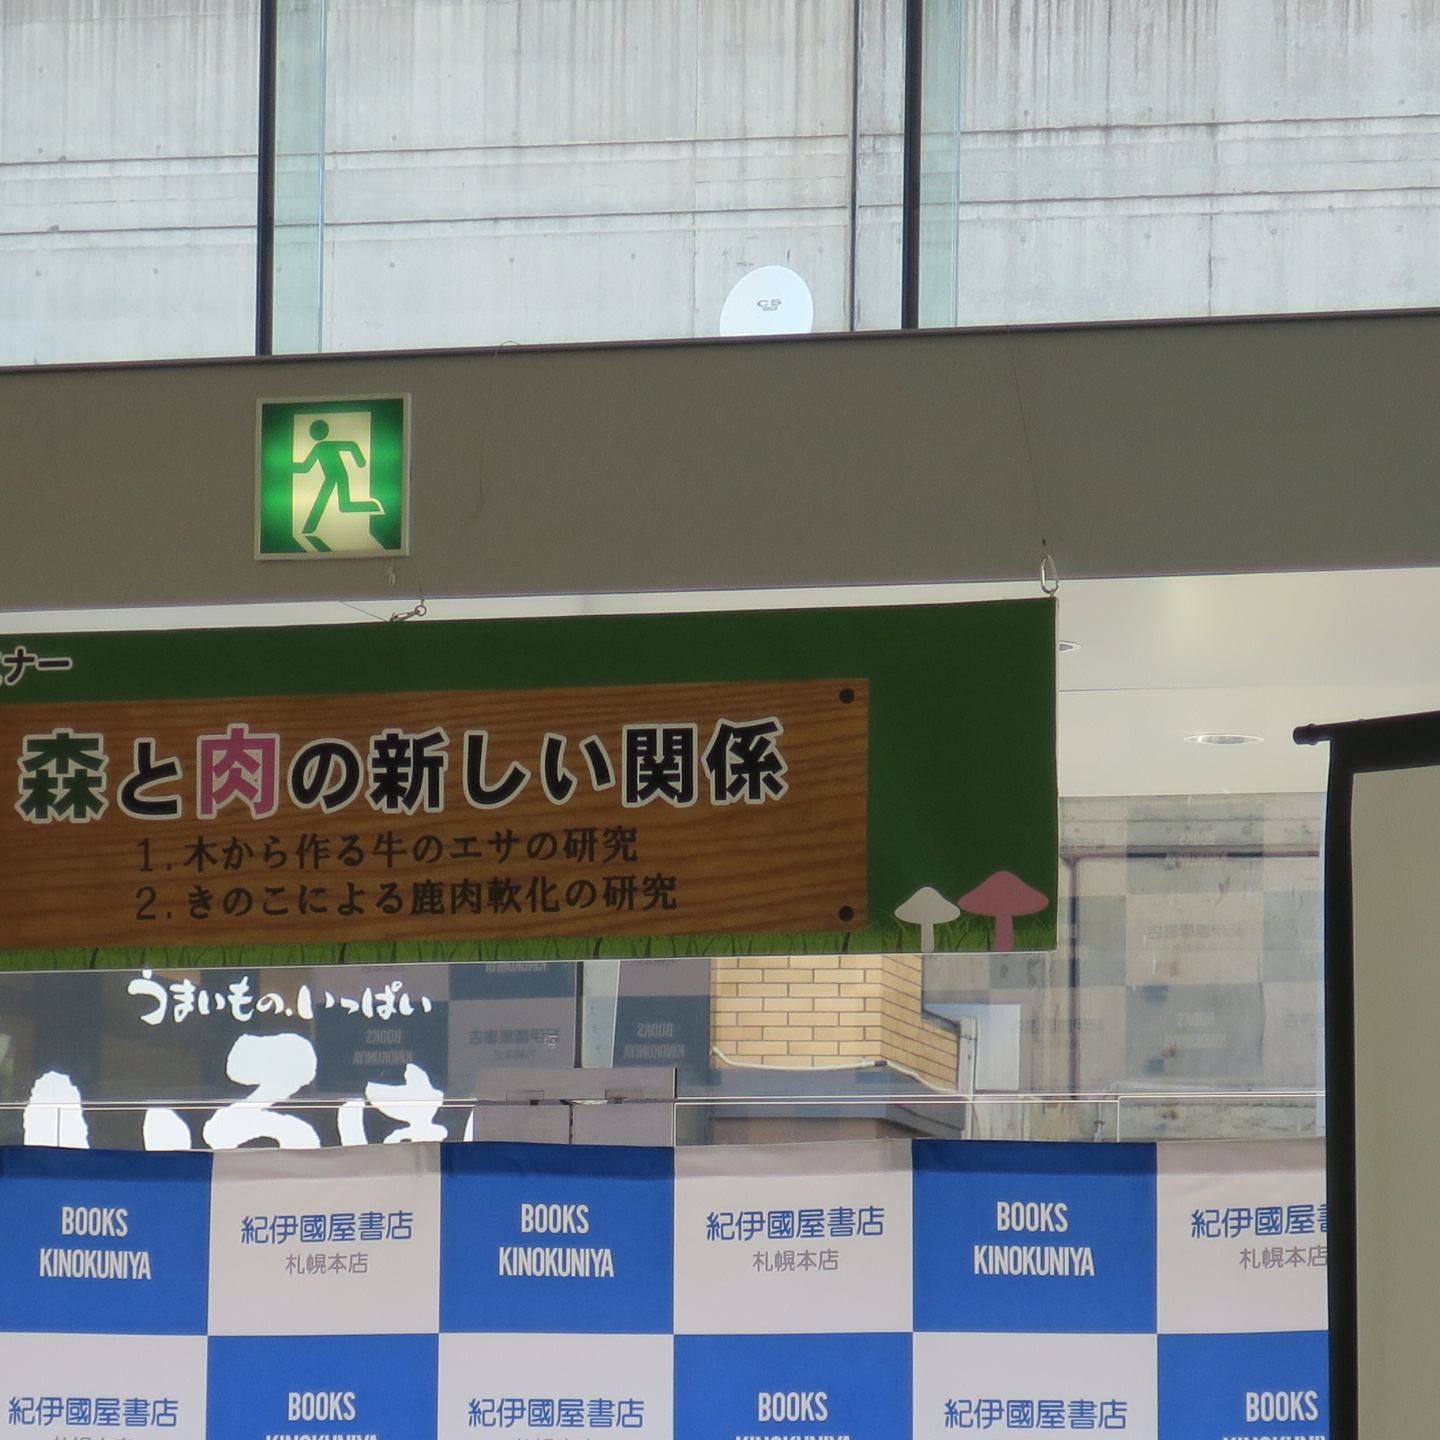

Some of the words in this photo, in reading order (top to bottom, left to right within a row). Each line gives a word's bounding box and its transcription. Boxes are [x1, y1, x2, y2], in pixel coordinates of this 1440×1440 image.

[16, 716, 791, 823] 森と肉の新しい関係
[62, 1207, 127, 1236] BOOKS
[242, 1210, 413, 1244] 紀伊國屋書店
[522, 1204, 589, 1233] BOOKS
[707, 1206, 884, 1241] 紀伊國屋書店
[997, 1202, 1068, 1232] BOOKS
[40, 1249, 151, 1279] KINOKUNIYA
[286, 1252, 368, 1274] 札幌本店
[499, 1247, 614, 1277] KINOKUNIYA
[753, 1249, 838, 1272] 札幌本店
[975, 1245, 1094, 1276] KINOKUNIYA
[9, 1397, 178, 1427] 紀伊國屋書店
[289, 1392, 355, 1420] BOOKS
[469, 1398, 644, 1428] 紀伊國屋書店
[759, 1392, 827, 1421] BOOKS
[945, 1399, 1127, 1429] 紀伊國屋書店
[1246, 1391, 1318, 1421] BOOKS
